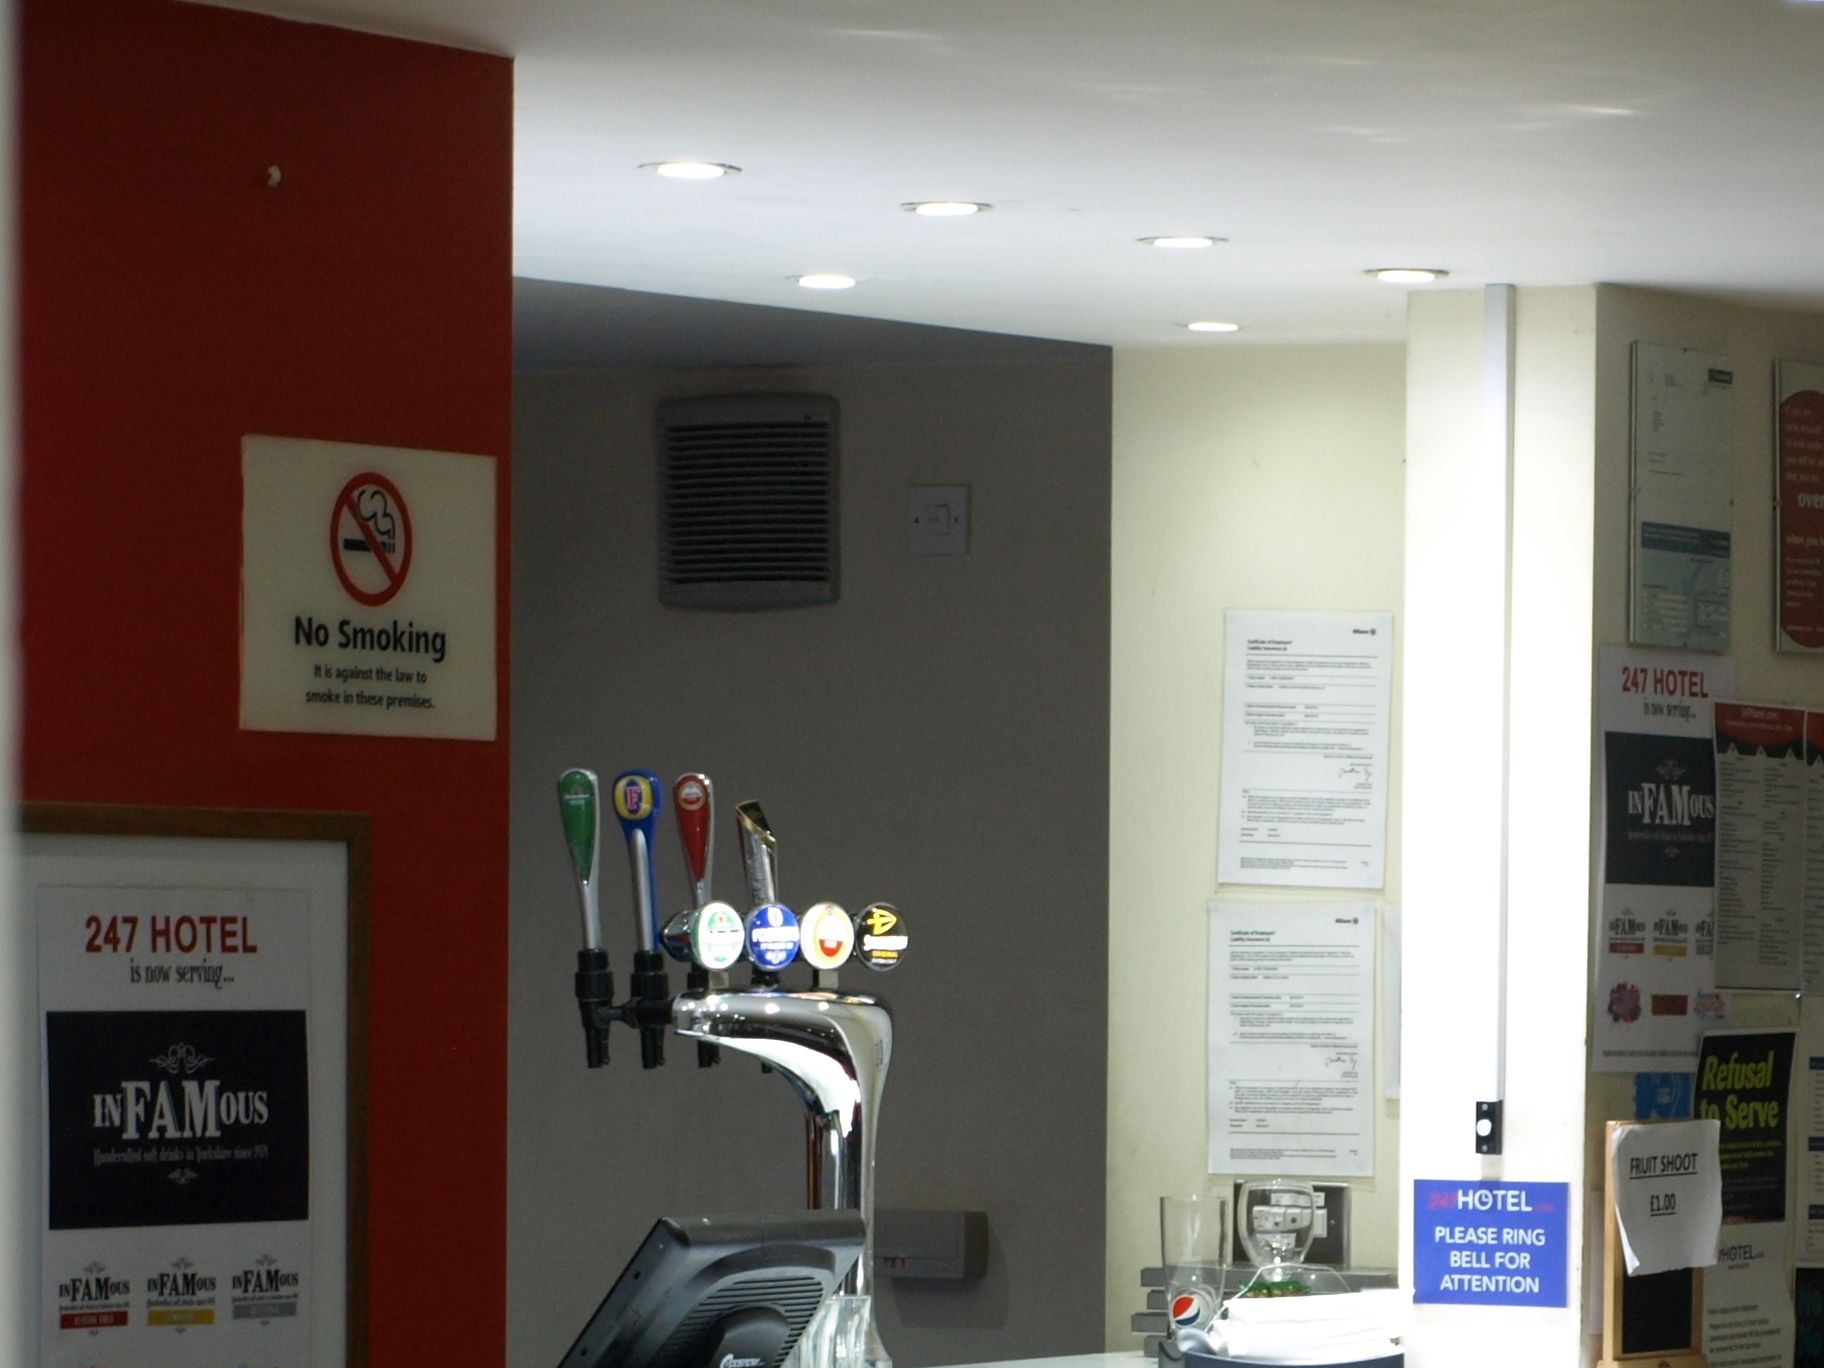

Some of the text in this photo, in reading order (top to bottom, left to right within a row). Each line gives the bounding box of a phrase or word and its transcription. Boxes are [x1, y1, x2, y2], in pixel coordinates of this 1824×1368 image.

[294, 616, 446, 662] No Smoking
[314, 664, 428, 684] It is against the law to
[1622, 666, 1709, 699] 247 HOTEL
[305, 688, 341, 703] smoke
[343, 689, 354, 704] in
[356, 690, 384, 706] these
[85, 914, 258, 953] 247 HOTEL
[130, 958, 141, 984] is
[145, 965, 171, 983] now
[1702, 1050, 1776, 1091] Refusal
[1725, 1092, 1780, 1131] Serve
[1630, 1156, 1658, 1175] FRUIT
[1660, 1153, 1698, 1173] SHOOT
[1650, 1193, 1676, 1213] £1.00
[1434, 1226, 1546, 1246] PLEASE RING
[1450, 1250, 1531, 1269] BELL FOR
[1439, 1274, 1540, 1293] ATTENTION
